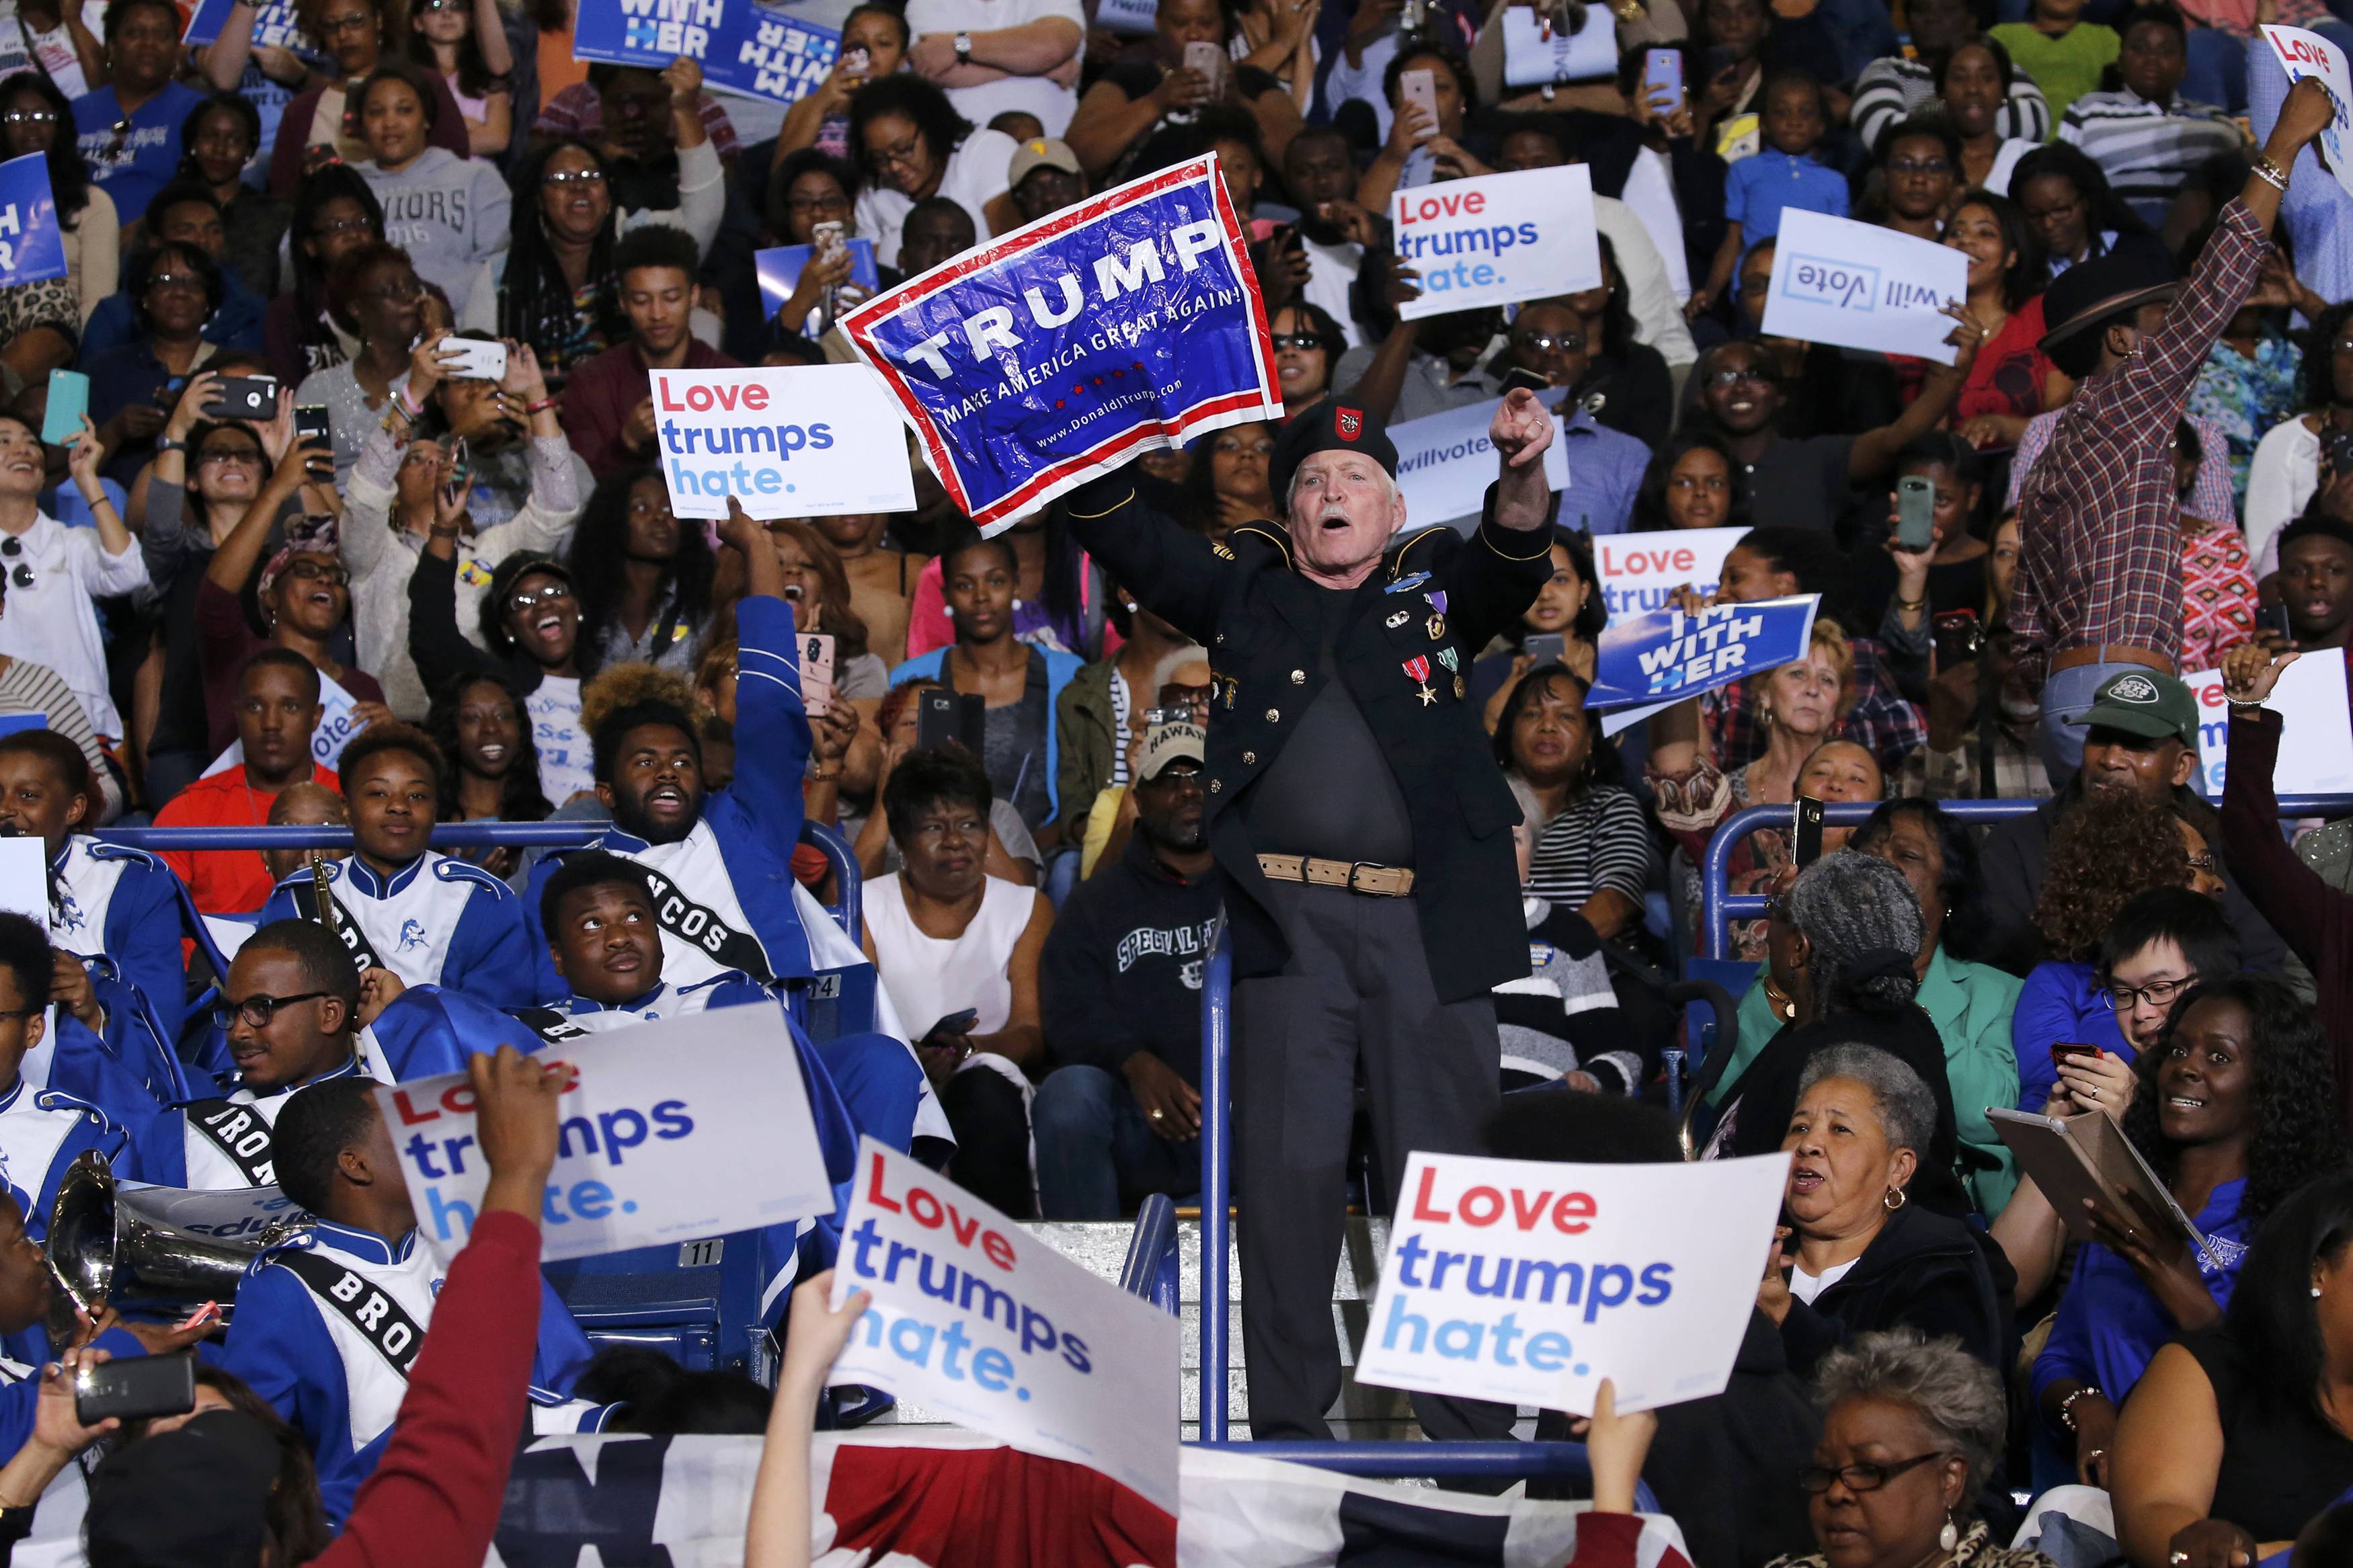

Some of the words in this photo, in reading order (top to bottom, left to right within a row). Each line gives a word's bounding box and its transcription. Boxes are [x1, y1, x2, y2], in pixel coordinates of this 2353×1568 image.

[624, 16, 710, 59] HER
[756, 20, 837, 64] HER
[2269, 31, 2331, 74] Love
[384, 188, 465, 235] IORS
[1400, 190, 1486, 226] Love
[1398, 221, 1540, 259] trumps
[904, 218, 1222, 382] TRUMP
[1798, 265, 1866, 308] Vote
[1885, 280, 1939, 309] will
[941, 388, 992, 426] MAKE
[998, 342, 1086, 400] AMERICA
[1090, 314, 1158, 352] GREAT
[1165, 286, 1242, 322] AGAIN!
[658, 376, 770, 412] Love
[661, 418, 834, 462] trumps
[670, 457, 797, 497] hate.
[1602, 547, 1696, 577] Love
[1638, 614, 1764, 676] WITH
[1648, 643, 1747, 695] HER
[313, 716, 352, 757] ote
[405, 1100, 694, 1179] trmps
[425, 1180, 638, 1241] hte.
[868, 1151, 1018, 1273] Love
[1412, 1166, 1598, 1235] Love
[691, 1241, 713, 1266] 11
[852, 1218, 1092, 1375] trumps
[1396, 1233, 1675, 1325] trumps
[329, 1270, 420, 1373] BRO
[1380, 1294, 1591, 1378] hate.
